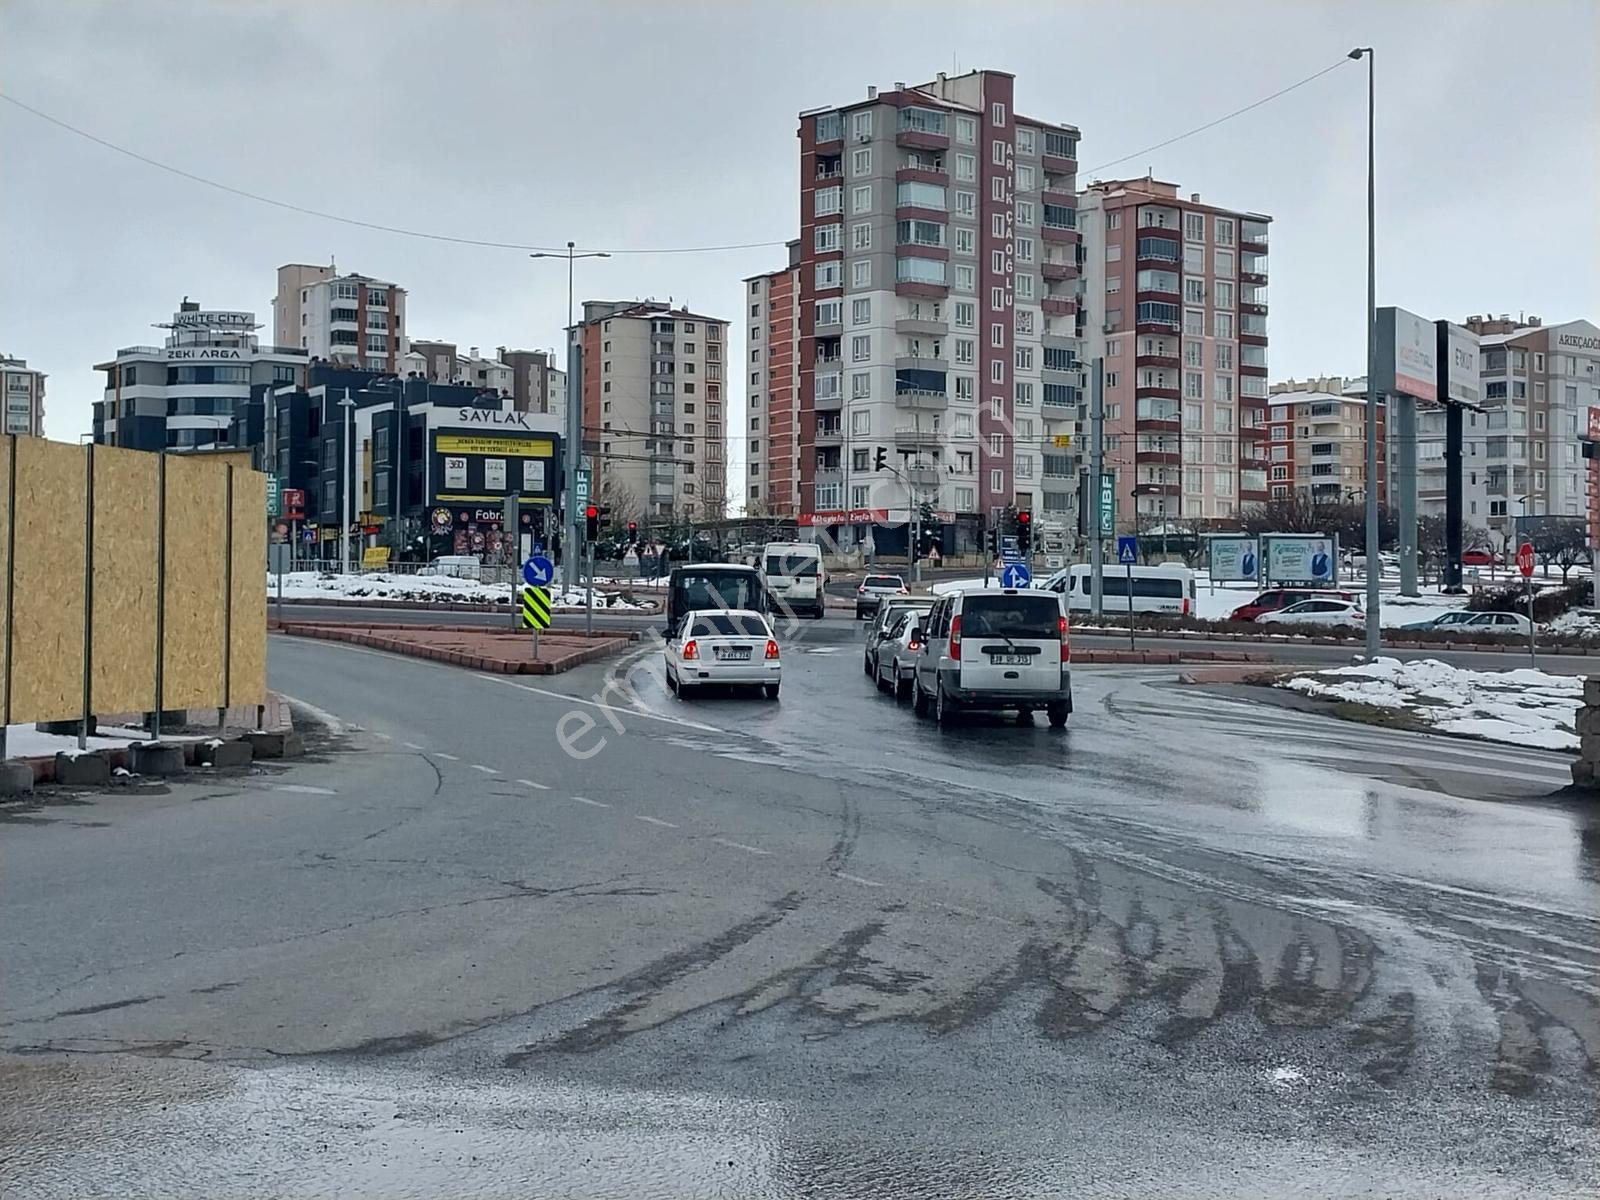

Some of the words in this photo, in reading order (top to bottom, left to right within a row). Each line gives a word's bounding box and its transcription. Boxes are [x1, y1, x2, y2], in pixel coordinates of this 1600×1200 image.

[1004, 142, 1015, 308] ARIKÇAOĞLU
[199, 349, 241, 359] ARGA
[459, 408, 532, 431] SAYLAK
